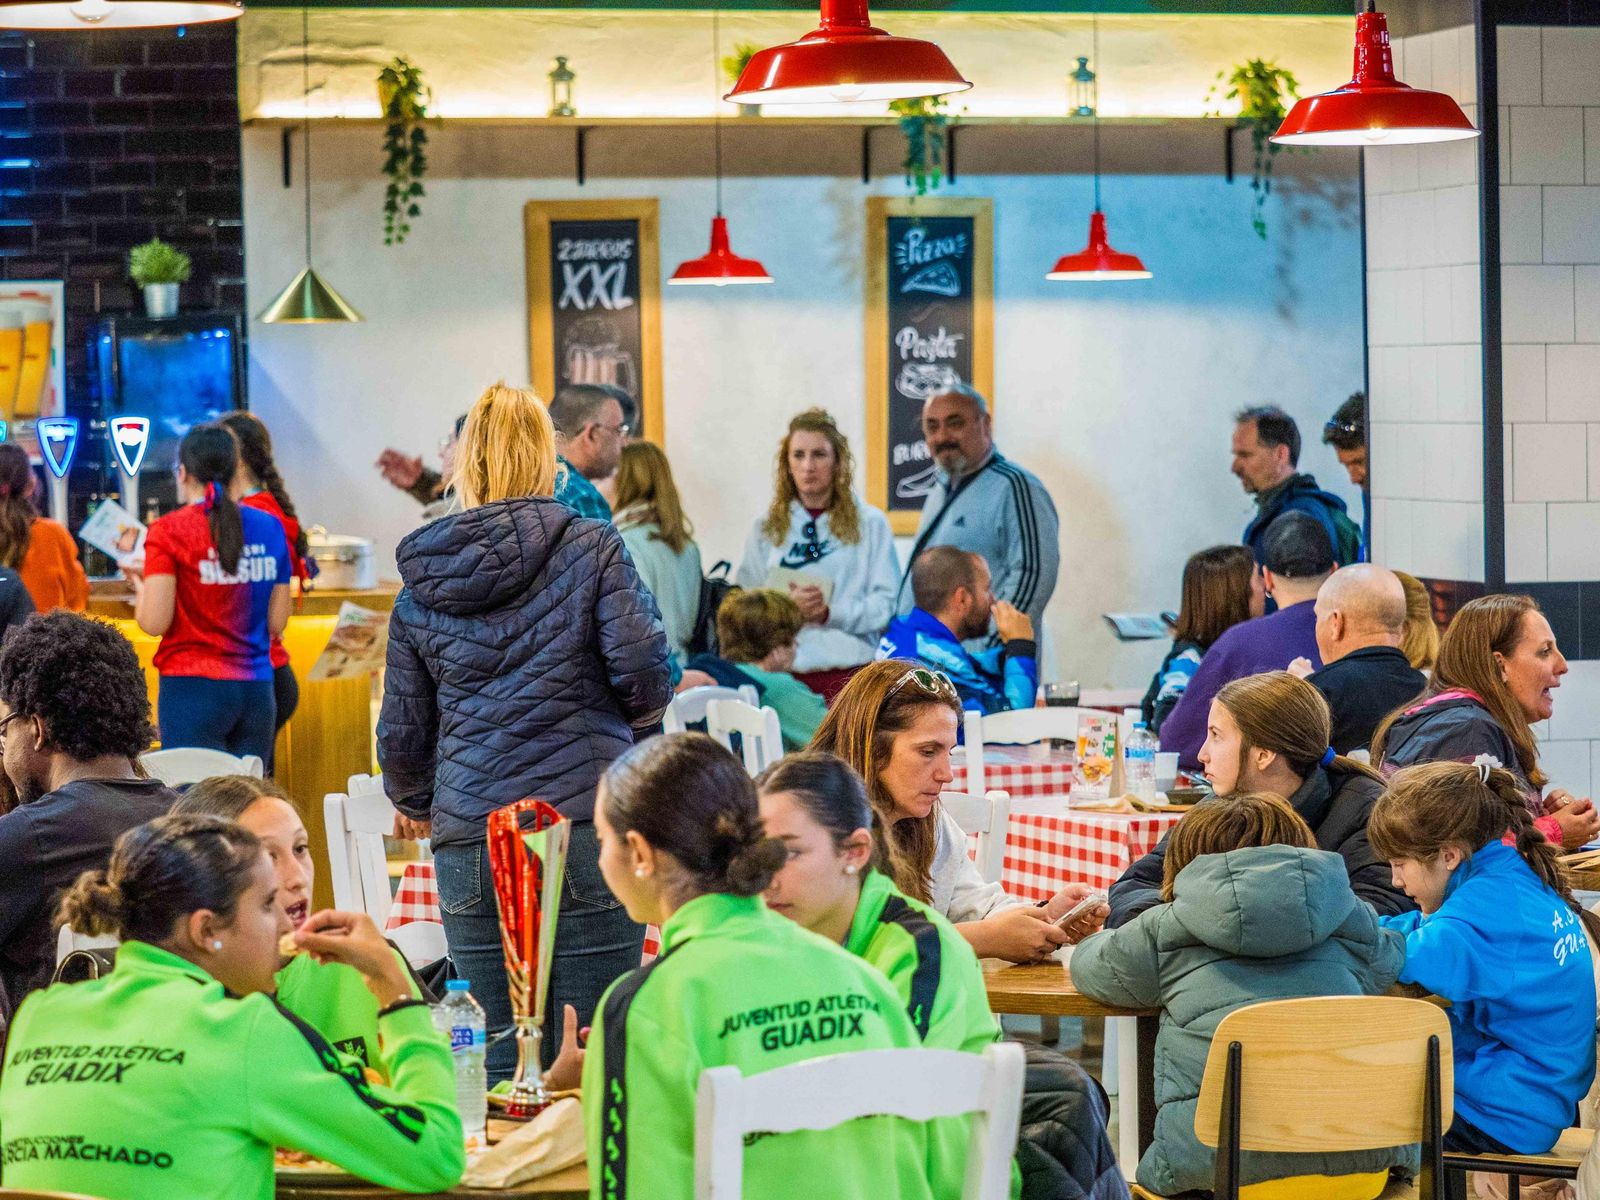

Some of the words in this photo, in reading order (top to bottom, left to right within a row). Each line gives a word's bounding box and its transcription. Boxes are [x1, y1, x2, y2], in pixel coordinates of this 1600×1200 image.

[558, 261, 634, 310] XXL
[895, 326, 965, 362] Pasta
[893, 440, 931, 465] BUR
[717, 1001, 811, 1039] JUVENTUD
[761, 1014, 864, 1051] GUADIX
[26, 1062, 136, 1086] GUADIX
[44, 1143, 174, 1169] MACHADO
